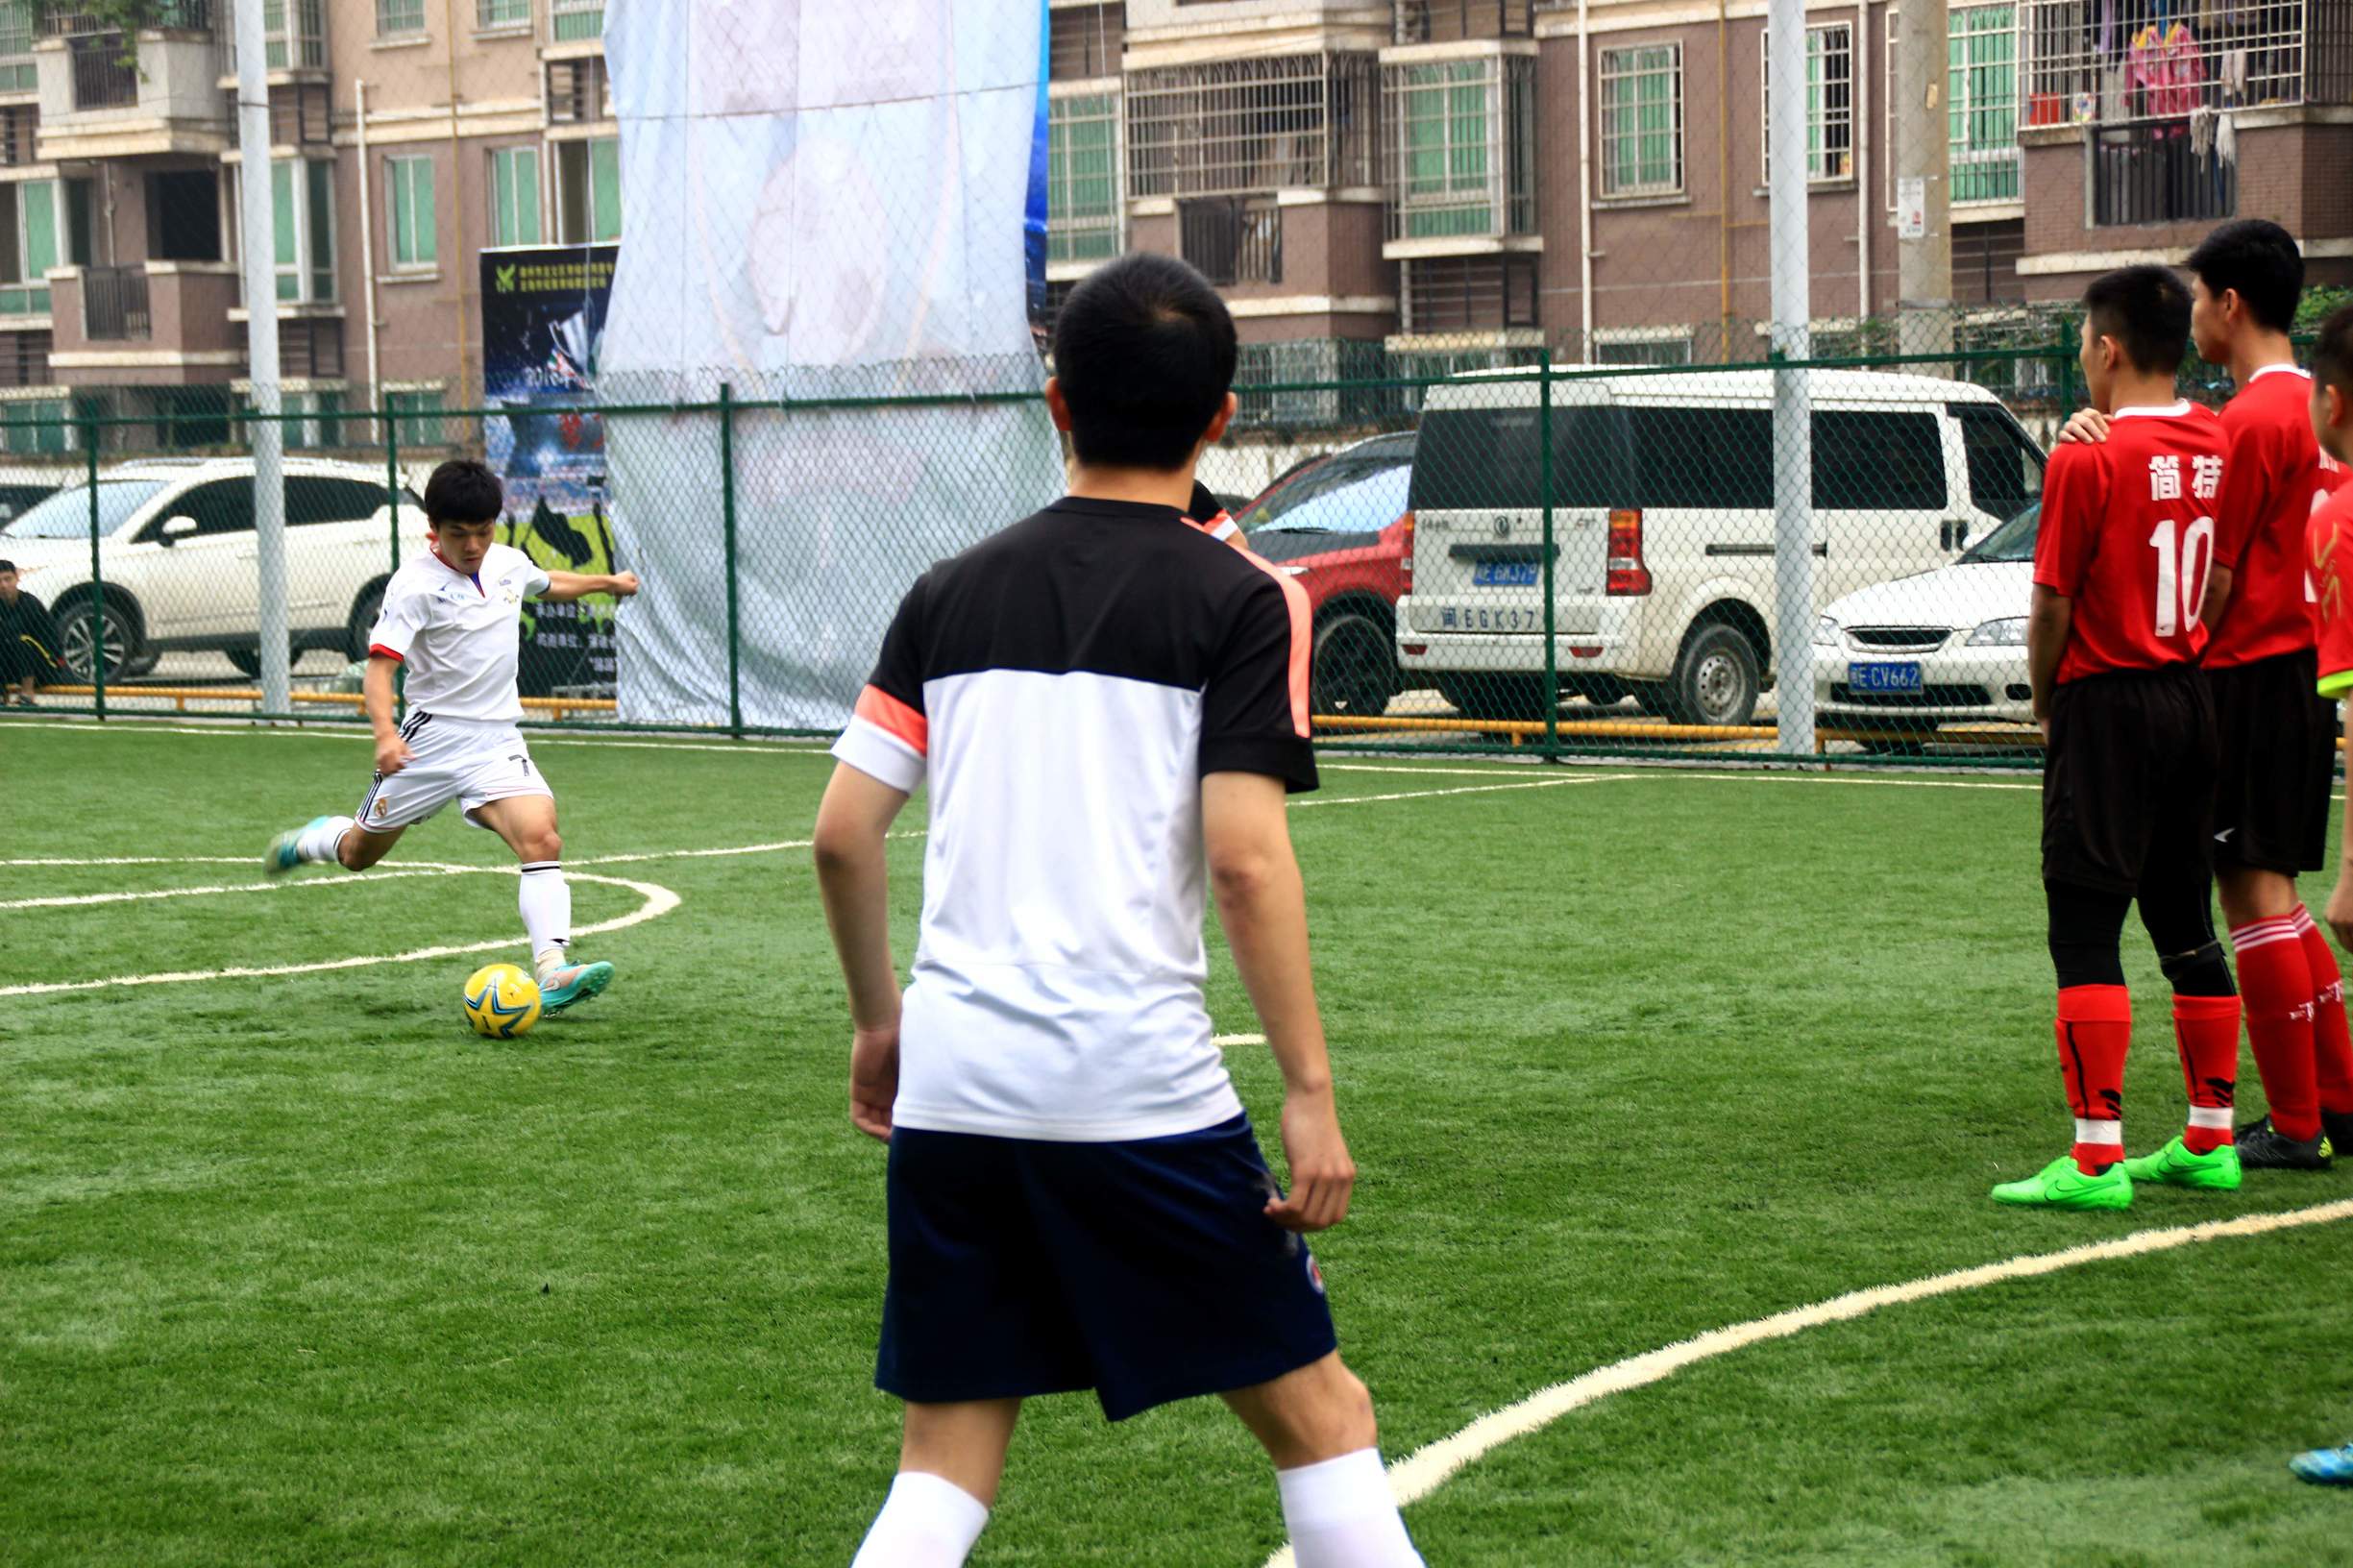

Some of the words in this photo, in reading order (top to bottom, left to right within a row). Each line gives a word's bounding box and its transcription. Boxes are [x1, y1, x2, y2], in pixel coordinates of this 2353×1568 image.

[2147, 454, 2223, 501] 简特
[2148, 515, 2215, 638] 10
[507, 754, 530, 776] 7
